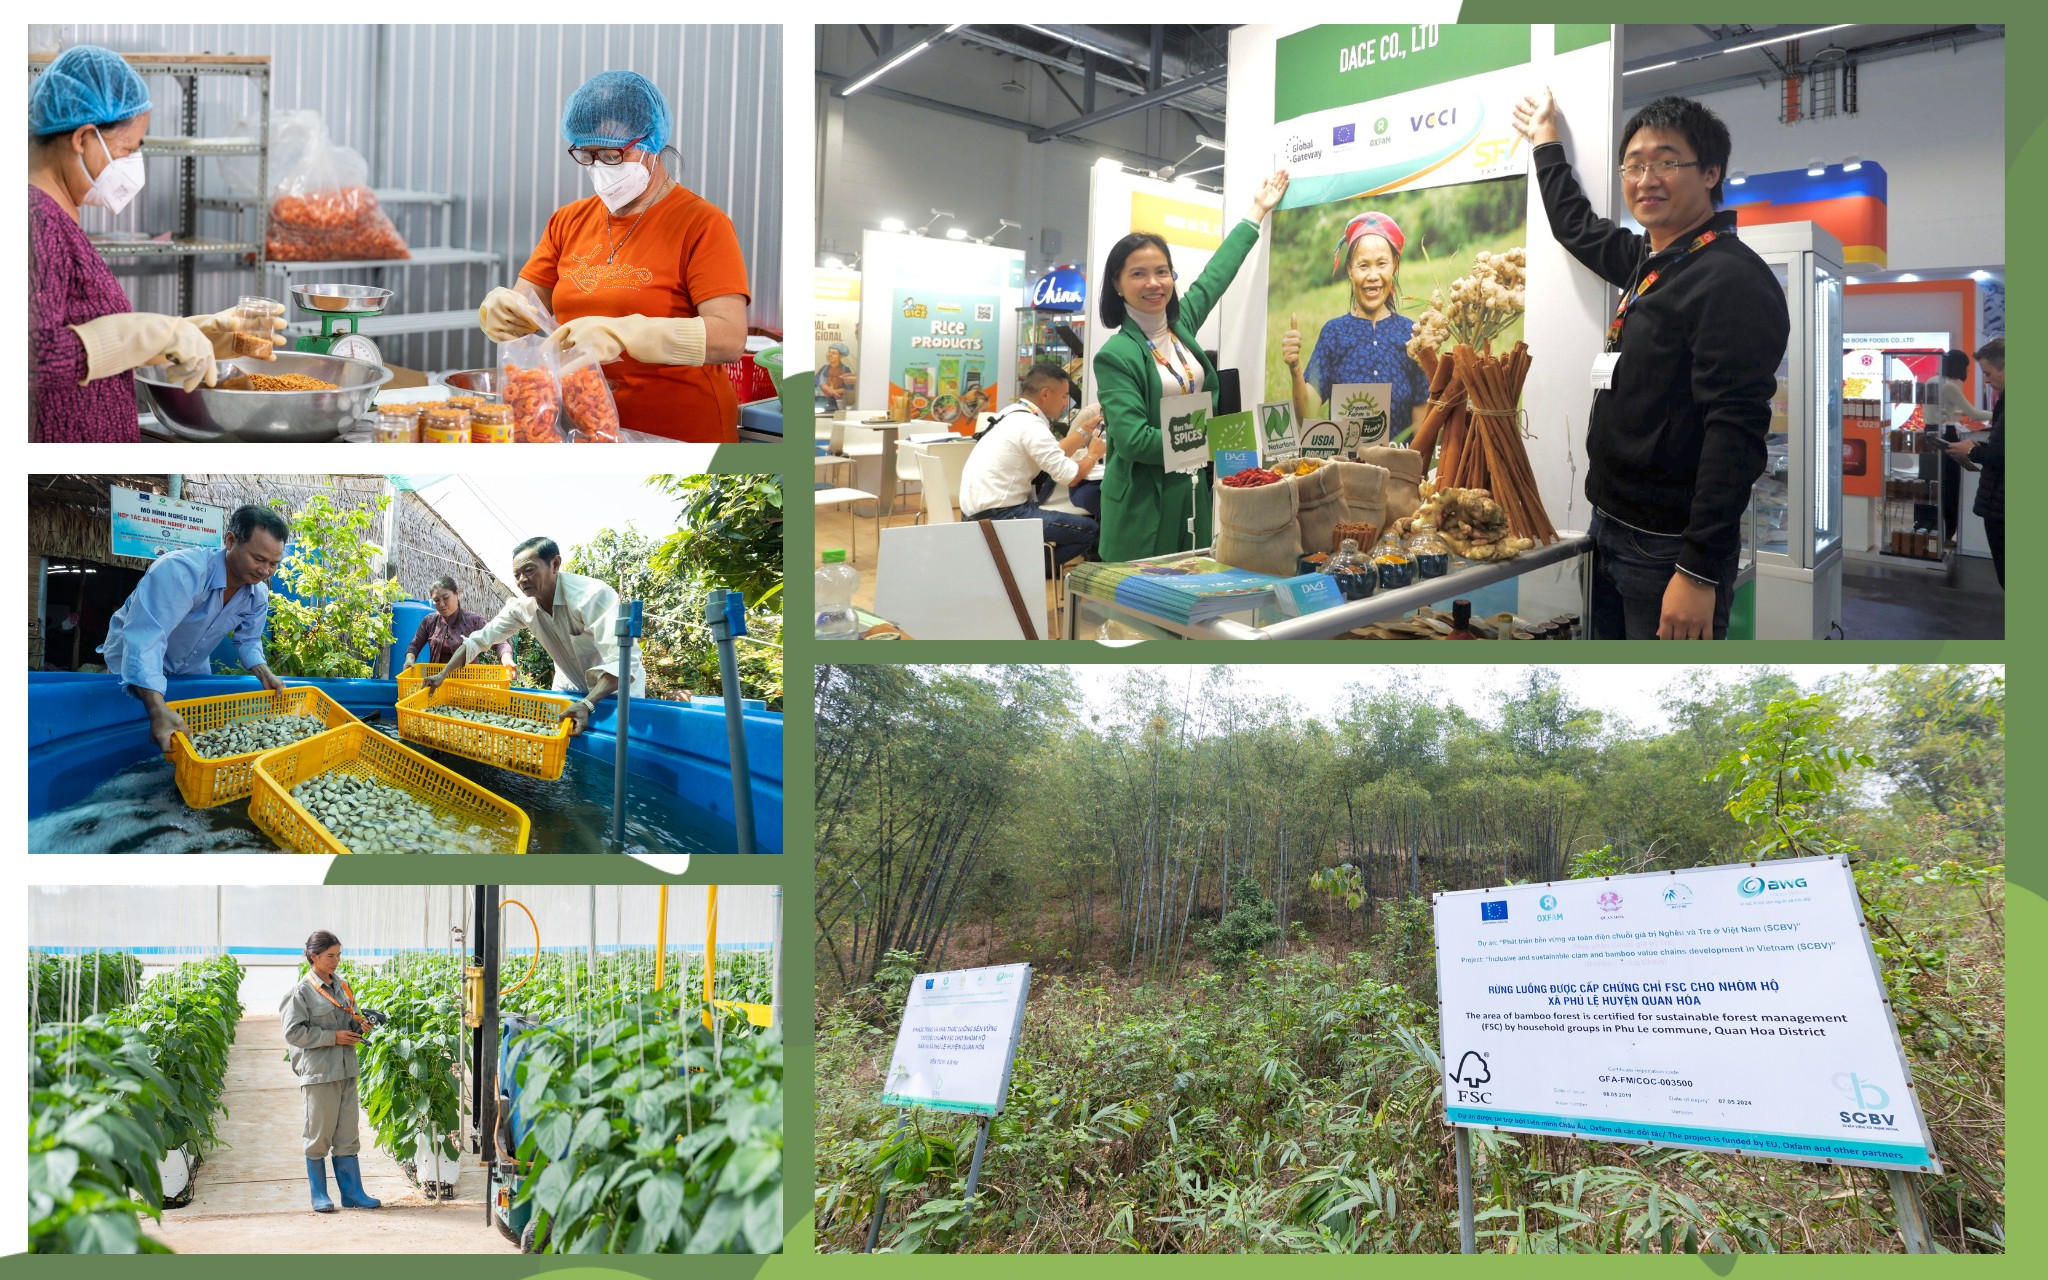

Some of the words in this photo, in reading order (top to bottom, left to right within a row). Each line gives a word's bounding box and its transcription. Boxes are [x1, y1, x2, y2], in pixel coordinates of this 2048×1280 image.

[1340, 39, 1376, 72] DACE
[1380, 32, 1406, 61] CO.,
[1412, 24, 1439, 53] LTD
[1410, 108, 1456, 132] VCCI
[1293, 139, 1313, 152] Global
[1369, 137, 1391, 147] OXFAM
[1292, 150, 1322, 163] Gateway
[1033, 276, 1084, 306] China
[911, 336, 983, 350] PRODUCTS
[1173, 424, 1184, 432] More
[1174, 428, 1203, 445] SPICES
[1311, 435, 1335, 446] USDA
[1268, 440, 1296, 451] Naturland
[1768, 877, 1808, 891] BWG
[1537, 913, 1563, 922] OXFAM
[1477, 939, 1487, 948] Dự
[1611, 931, 1633, 940] chuỗi
[1658, 928, 1685, 940] Nghêu
[1686, 928, 1696, 936] và
[1722, 925, 1739, 935] Việt
[1741, 924, 1761, 933] Nam
[1461, 956, 1484, 964] Project:
[1532, 952, 1570, 961] sustainable
[1571, 951, 1588, 959] clam
[1605, 949, 1636, 957] bamboo
[1637, 948, 1658, 956] value
[1660, 947, 1687, 956] chains
[1689, 945, 1743, 955] development
[1757, 943, 1795, 953] Vietnam
[1488, 983, 1513, 994] RỪNG
[1515, 982, 1547, 994] LUỒNG
[1549, 983, 1577, 996] ĐƯỢC
[1579, 980, 1599, 993] CẤP
[1602, 981, 1640, 993] CHỨNG
[1643, 979, 1662, 993] CHỈ
[1665, 982, 1687, 992] FSC
[1690, 982, 1715, 992] CHO
[1719, 979, 1758, 992] NHÓM
[1761, 978, 1780, 993] HỘ
[1548, 994, 1561, 1006] XÃ
[1563, 995, 1584, 1006] PHÚ
[1587, 994, 1599, 1007] LỆ
[1602, 994, 1639, 1007] HUYỆN
[1641, 995, 1673, 1006] QUAN
[1676, 994, 1702, 1006] HÓA
[1466, 1012, 1481, 1020] The
[1503, 1012, 1512, 1020] of
[1514, 1012, 1551, 1020] bamboo
[1553, 1012, 1580, 1020] forest
[1583, 1012, 1591, 1020] is
[1593, 1012, 1635, 1021] certified
[1637, 1012, 1652, 1021] for
[1655, 1012, 1719, 1021] sustainable
[1722, 1012, 1758, 1022] forest
[1761, 1013, 1848, 1024] management
[1481, 1023, 1503, 1032] (FSC)
[1504, 1023, 1516, 1033] by
[1517, 1023, 1565, 1032] household
[1567, 1025, 1600, 1034] groups
[1602, 1024, 1612, 1033] in
[1615, 1024, 1635, 1033] Phu
[1637, 1025, 1649, 1033] Le
[1652, 1026, 1712, 1036] commune,
[1714, 1026, 1747, 1036] Quan
[1750, 1026, 1775, 1036] Hoa
[1779, 1027, 1826, 1037] District
[1457, 1090, 1493, 1105] FSC
[1839, 1111, 1894, 1126] SCBV
[1457, 1112, 1467, 1121] Dự
[1476, 1113, 1492, 1122] được
[1514, 1116, 1526, 1125] bởi
[1541, 1119, 1558, 1128] minh
[1559, 1120, 1576, 1129] Châu
[1589, 1123, 1612, 1134] Oxfam
[1613, 1126, 1622, 1134] và
[1623, 1127, 1636, 1135] các
[1636, 1126, 1650, 1137] đối
[1667, 1131, 1682, 1140] The
[1683, 1133, 1712, 1144] project
[1713, 1135, 1721, 1143] is
[1721, 1135, 1751, 1146] funded
[1753, 1138, 1764, 1149] by
[1766, 1139, 1781, 1150] EU,
[1782, 1141, 1812, 1152] Oxfam
[1814, 1144, 1831, 1153] and
[1833, 1145, 1859, 1156] other
[1861, 1148, 1904, 1160] partners
